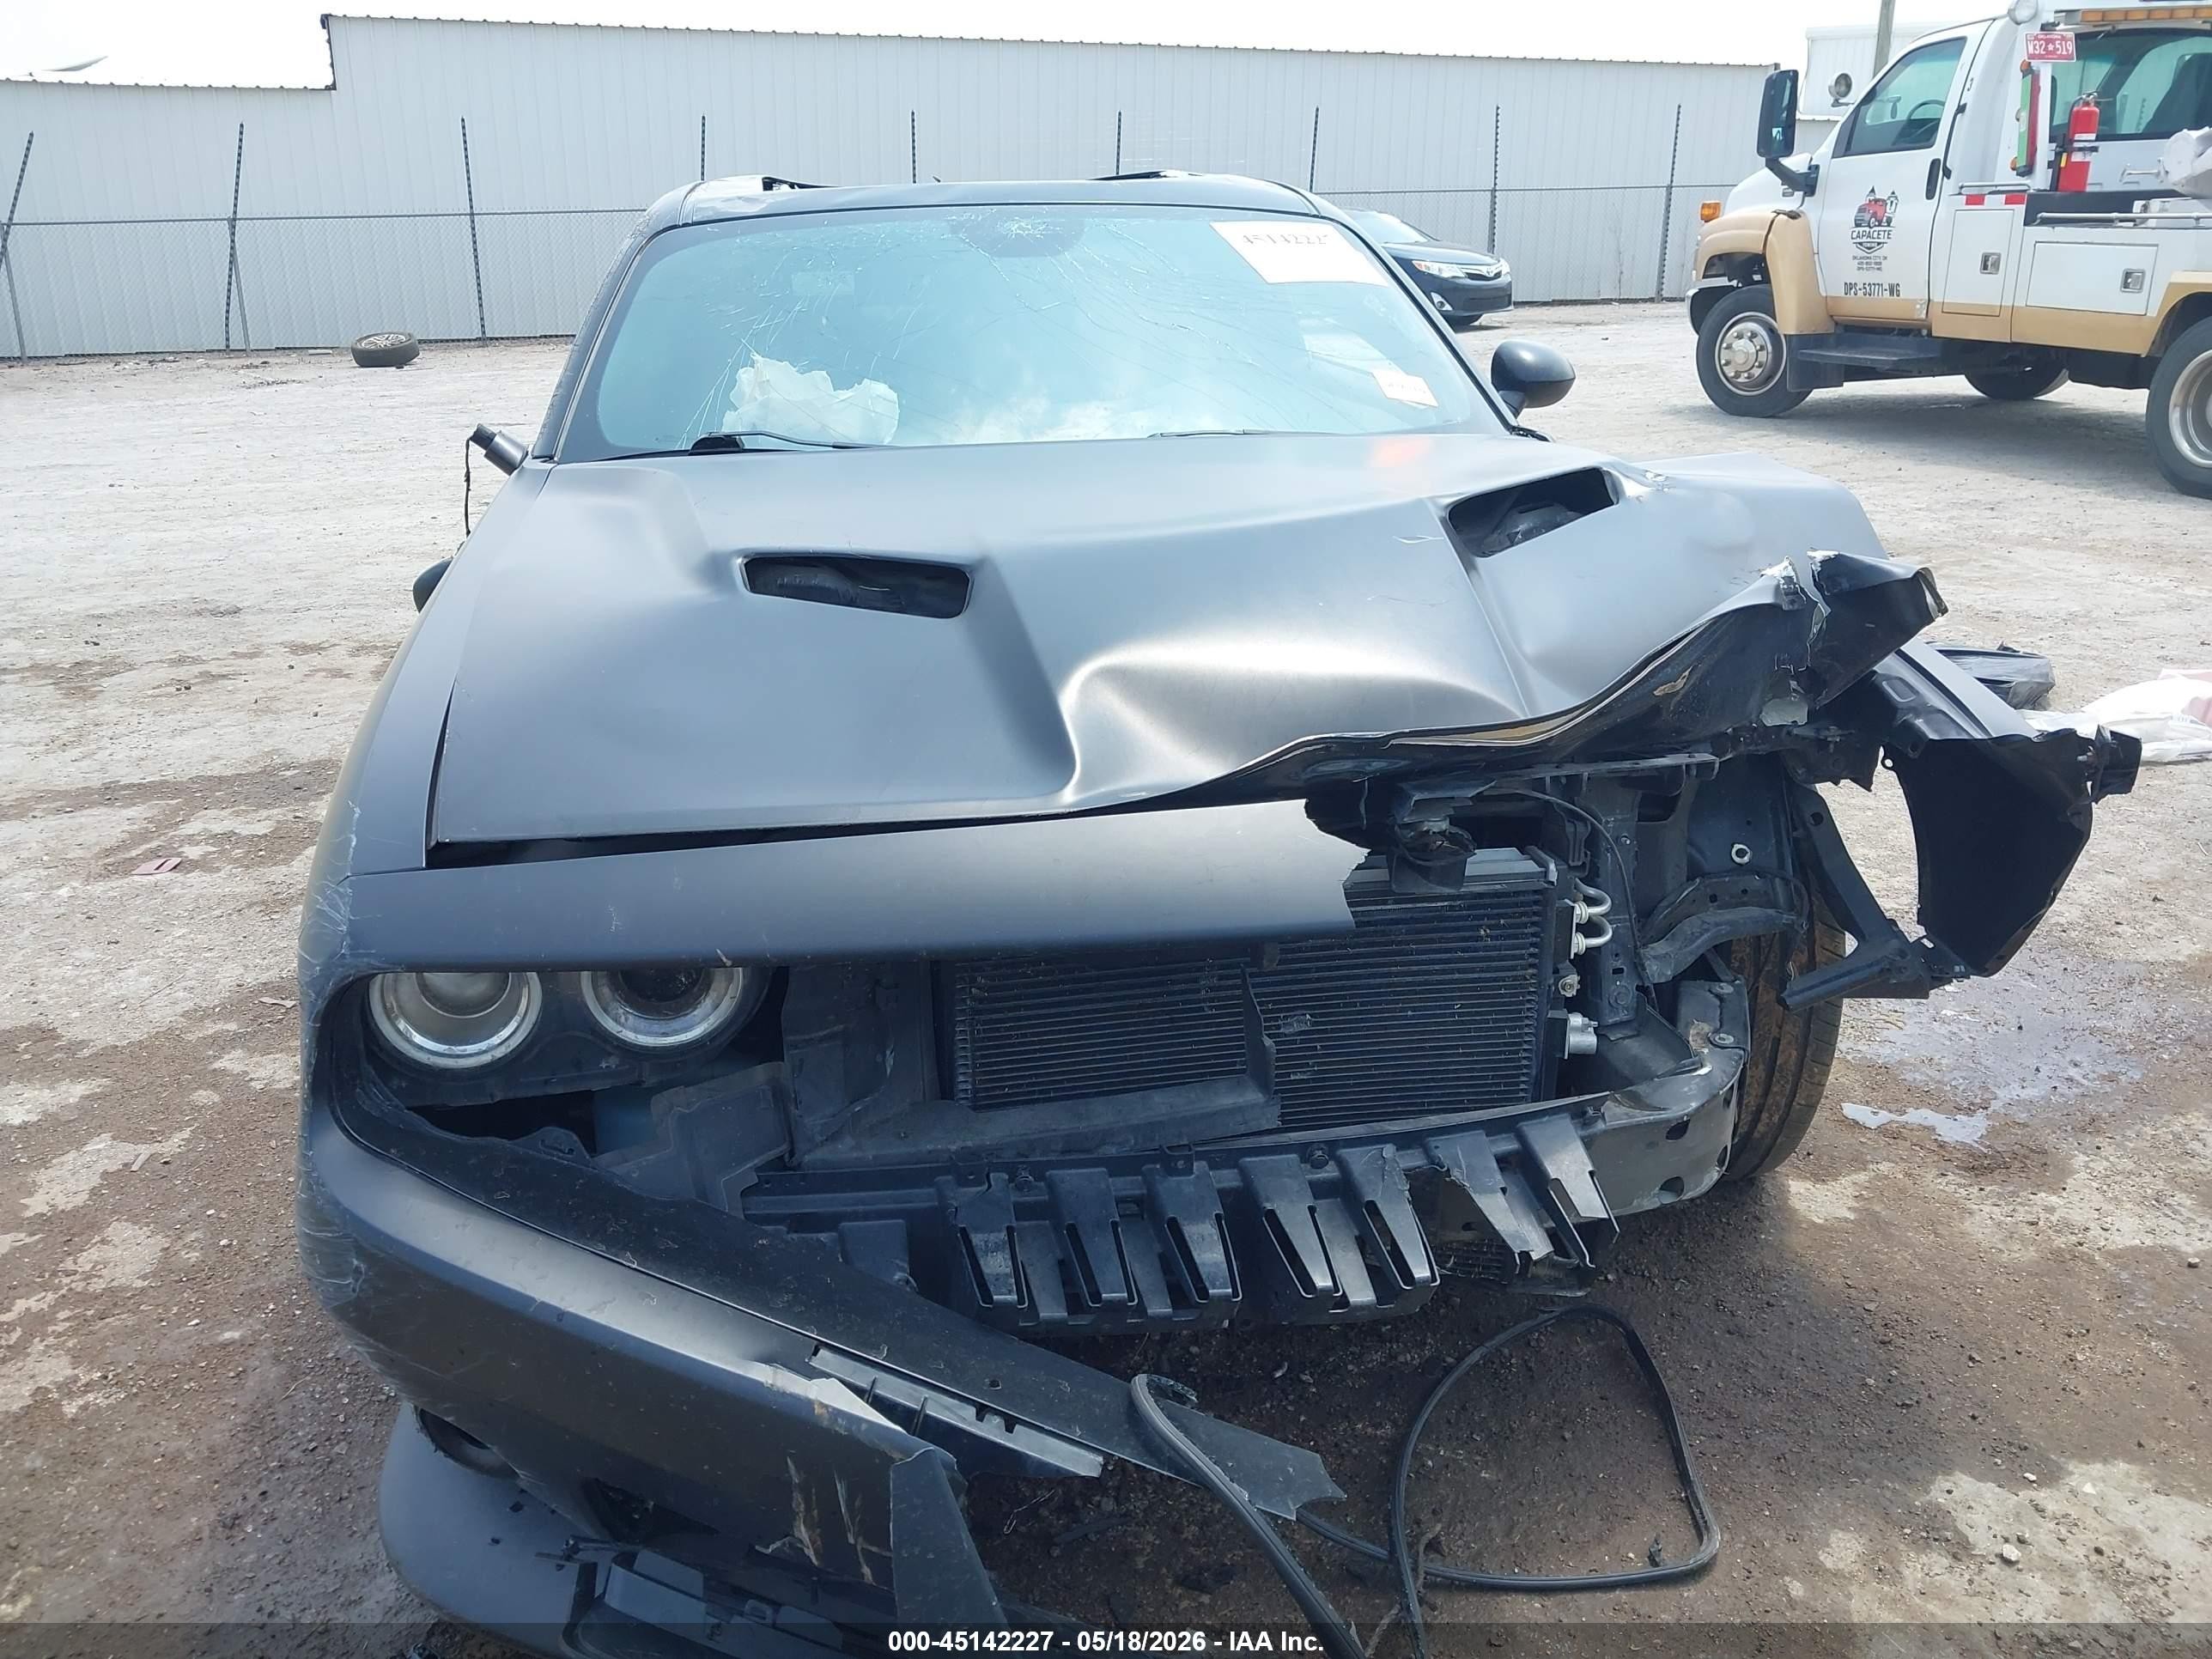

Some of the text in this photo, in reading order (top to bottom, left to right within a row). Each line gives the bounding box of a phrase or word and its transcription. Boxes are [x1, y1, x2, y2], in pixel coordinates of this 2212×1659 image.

[2055, 40, 2073, 56] 519
[1850, 229, 1893, 240] CAPACETE
[1844, 282, 1901, 298] DPS-53771-WG
